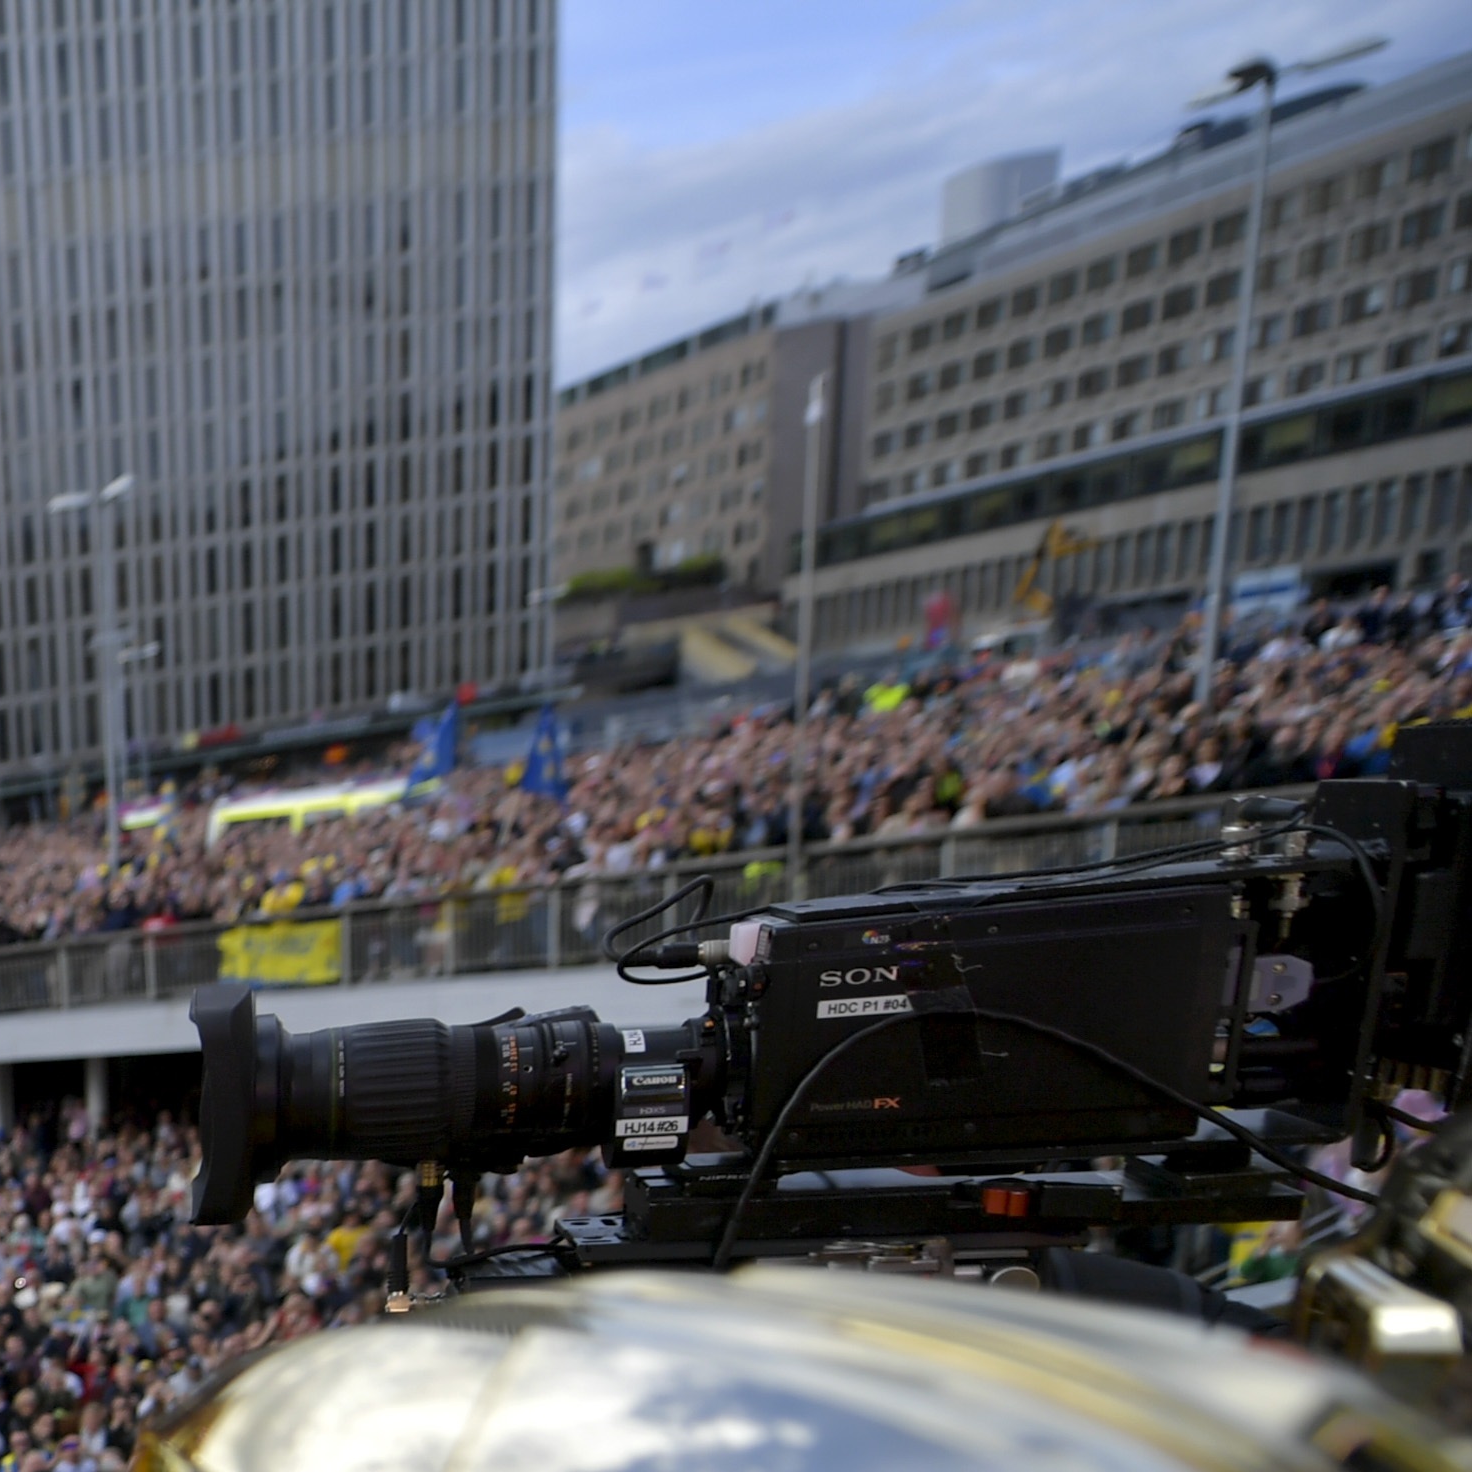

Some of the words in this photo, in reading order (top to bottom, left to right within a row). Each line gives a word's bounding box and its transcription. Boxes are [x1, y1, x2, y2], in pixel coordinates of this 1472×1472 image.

[819, 965, 900, 988] SON
[827, 1002, 858, 1015] HDC
[862, 1000, 879, 1012] P1
[882, 998, 908, 1011] #04
[632, 1075, 678, 1087] Canon
[624, 1121, 655, 1134] HJ14
[657, 1120, 679, 1133] #26
